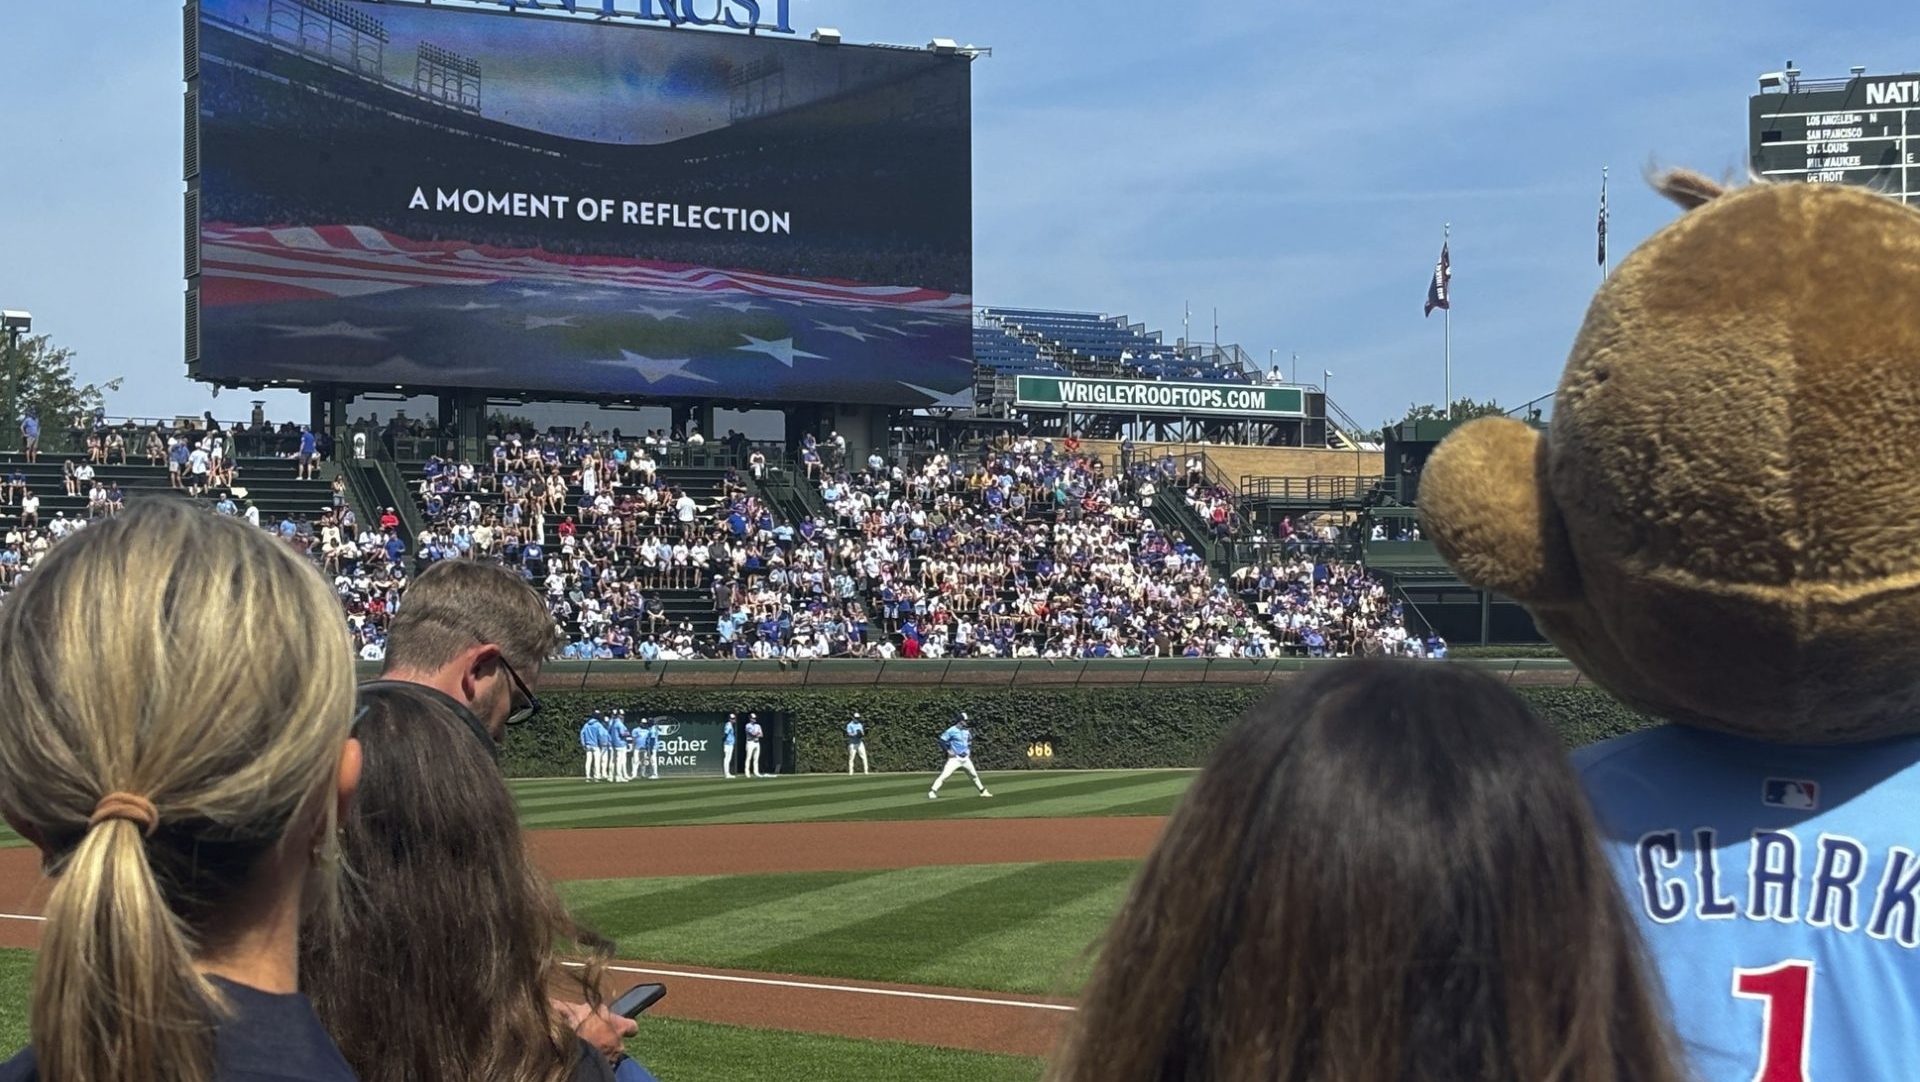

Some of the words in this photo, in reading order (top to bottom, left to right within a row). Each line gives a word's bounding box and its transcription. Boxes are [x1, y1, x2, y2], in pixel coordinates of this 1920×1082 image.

[1806, 115, 1820, 126] LOS
[1821, 113, 1853, 125] ANGELES
[1806, 129, 1821, 140] SAN
[1822, 127, 1863, 138] FRANCISCO
[1806, 142, 1821, 154] ST.
[1822, 142, 1849, 153] LOUIS
[1806, 156, 1861, 168] MILWAUKEE
[1807, 171, 1844, 183] DETROIT
[409, 186, 429, 210] A
[436, 187, 570, 219] MOMENT
[577, 198, 614, 222] OF
[622, 201, 790, 235] REFLECTION
[1058, 381, 1265, 409] WRIGLEYROOFTOPS.COM
[1636, 827, 1920, 948] CLARK
[1731, 958, 1815, 1082] 1
